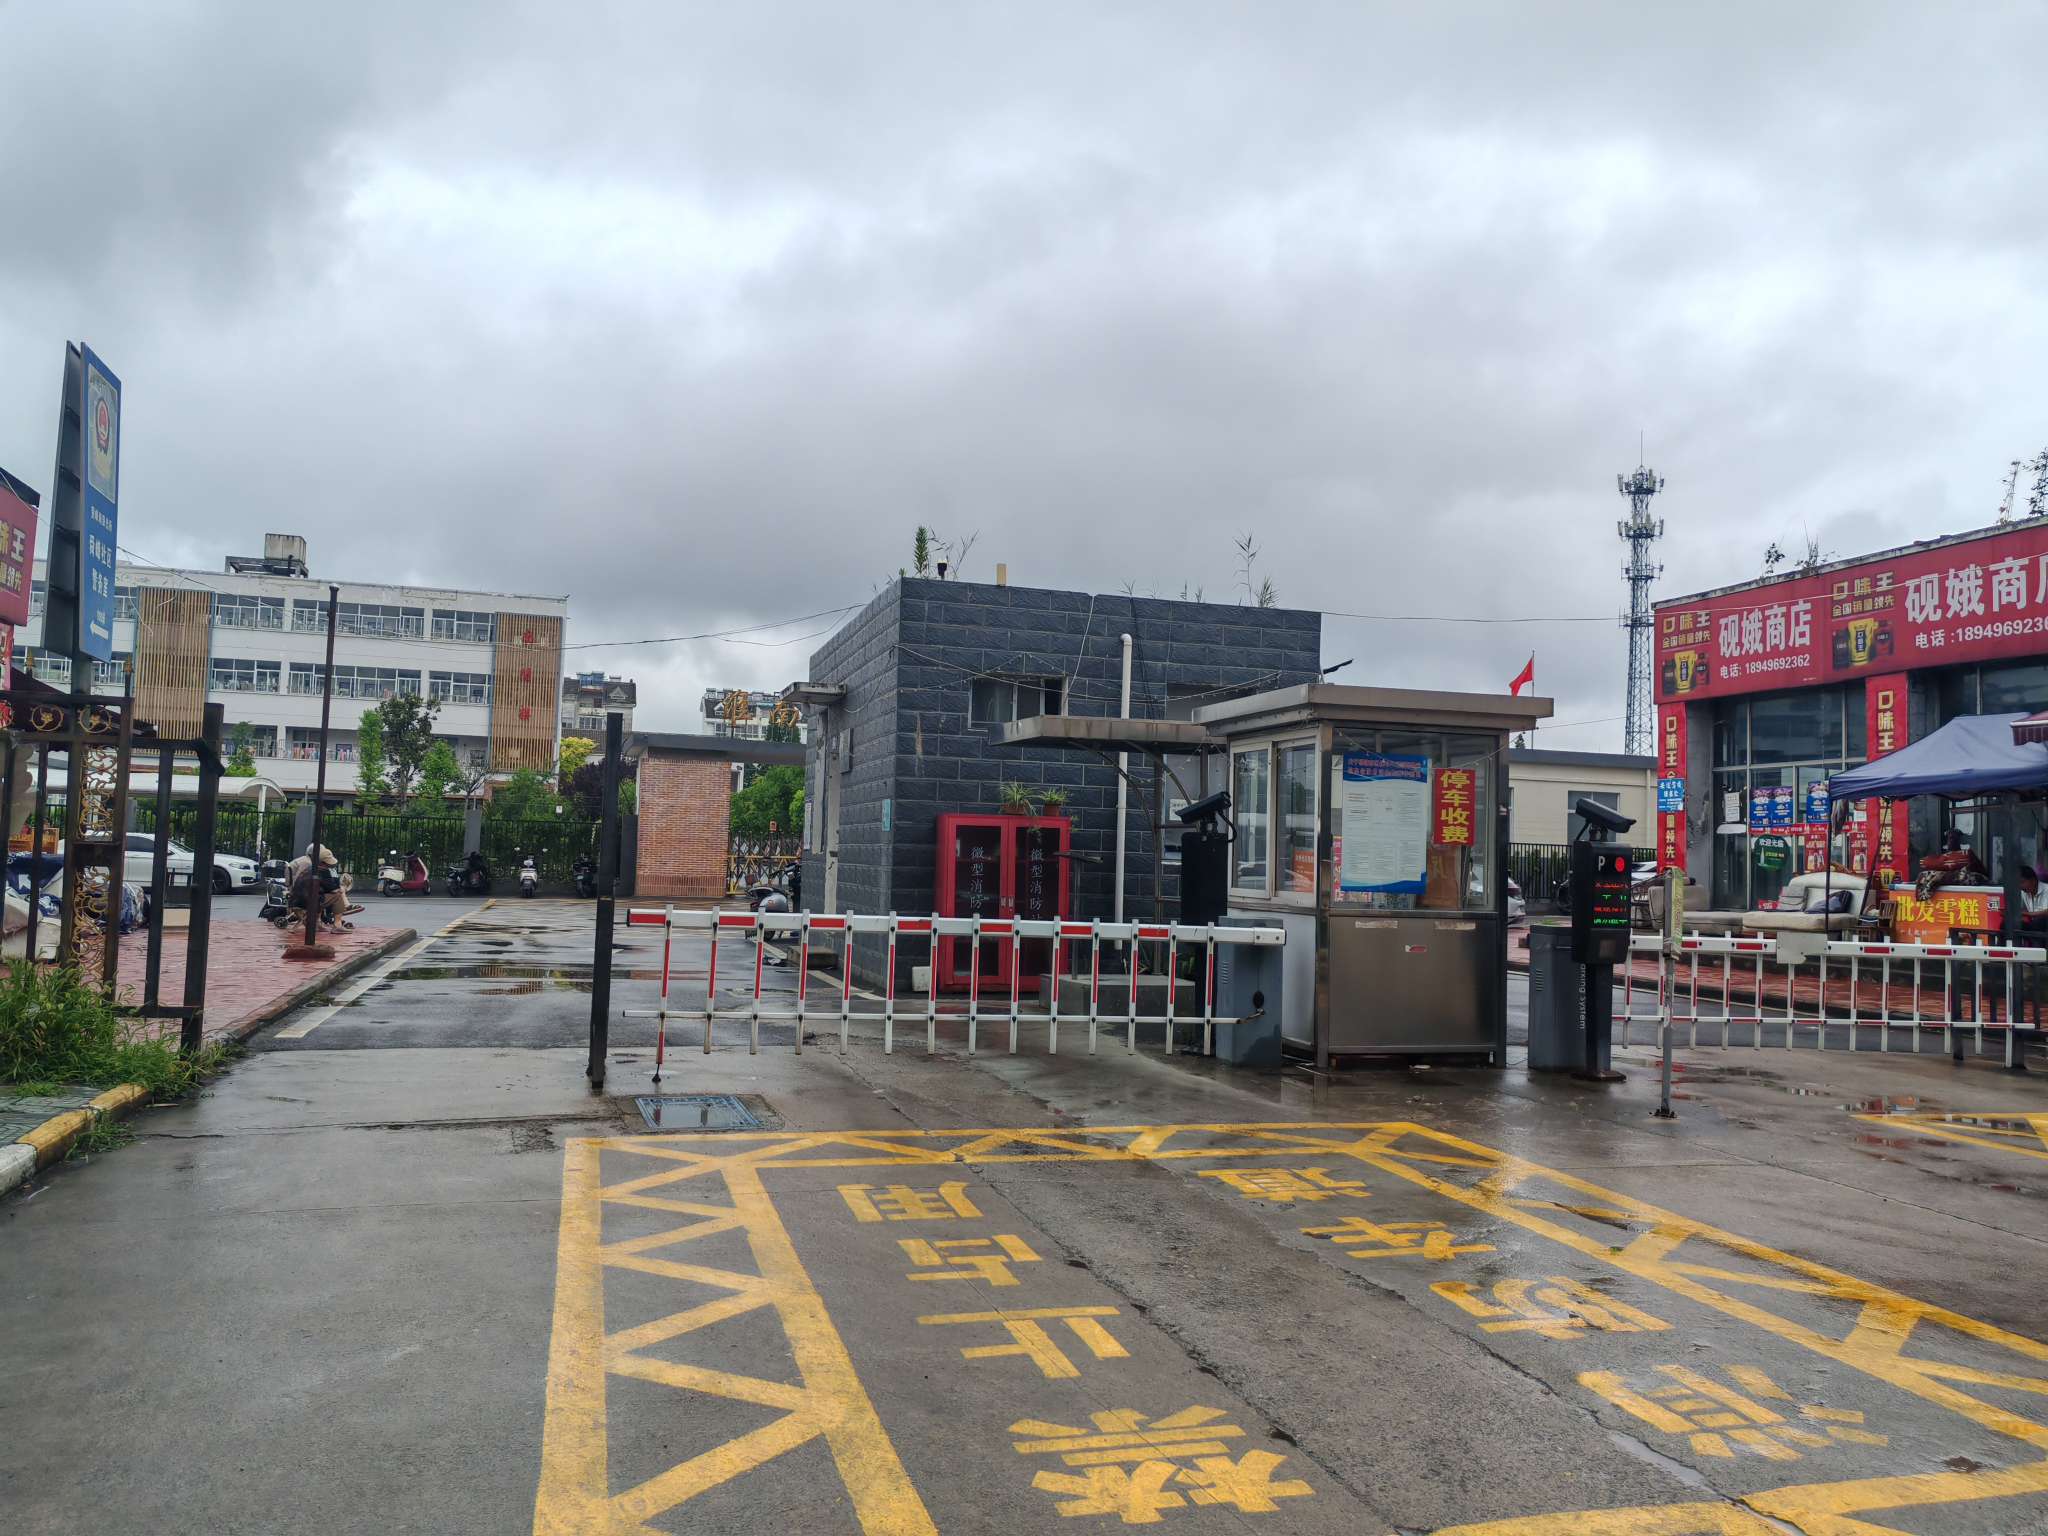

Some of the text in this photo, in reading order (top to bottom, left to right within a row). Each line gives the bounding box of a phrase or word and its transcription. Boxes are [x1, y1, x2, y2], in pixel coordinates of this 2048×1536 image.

[1832, 595, 1895, 617] 全国销量领先
[1833, 571, 1894, 600] 口味王
[1662, 611, 1711, 633] 口味王
[1662, 630, 1711, 648] 全国销量领先
[1718, 600, 1812, 659] 砚娥商店
[1745, 653, 1810, 674] 18949692362
[1666, 716, 1677, 767] 口味王
[1878, 691, 1895, 751] 口味王
[1441, 770, 1470, 843] 停车收费
[969, 846, 985, 912] 微型消防
[1030, 848, 1044, 920] 微型消防
[1598, 855, 1606, 871] P
[1896, 895, 1981, 926] 批发雪糕
[1197, 1167, 1889, 1461] 消防车道
[838, 1181, 1316, 1524] 禁止占用
